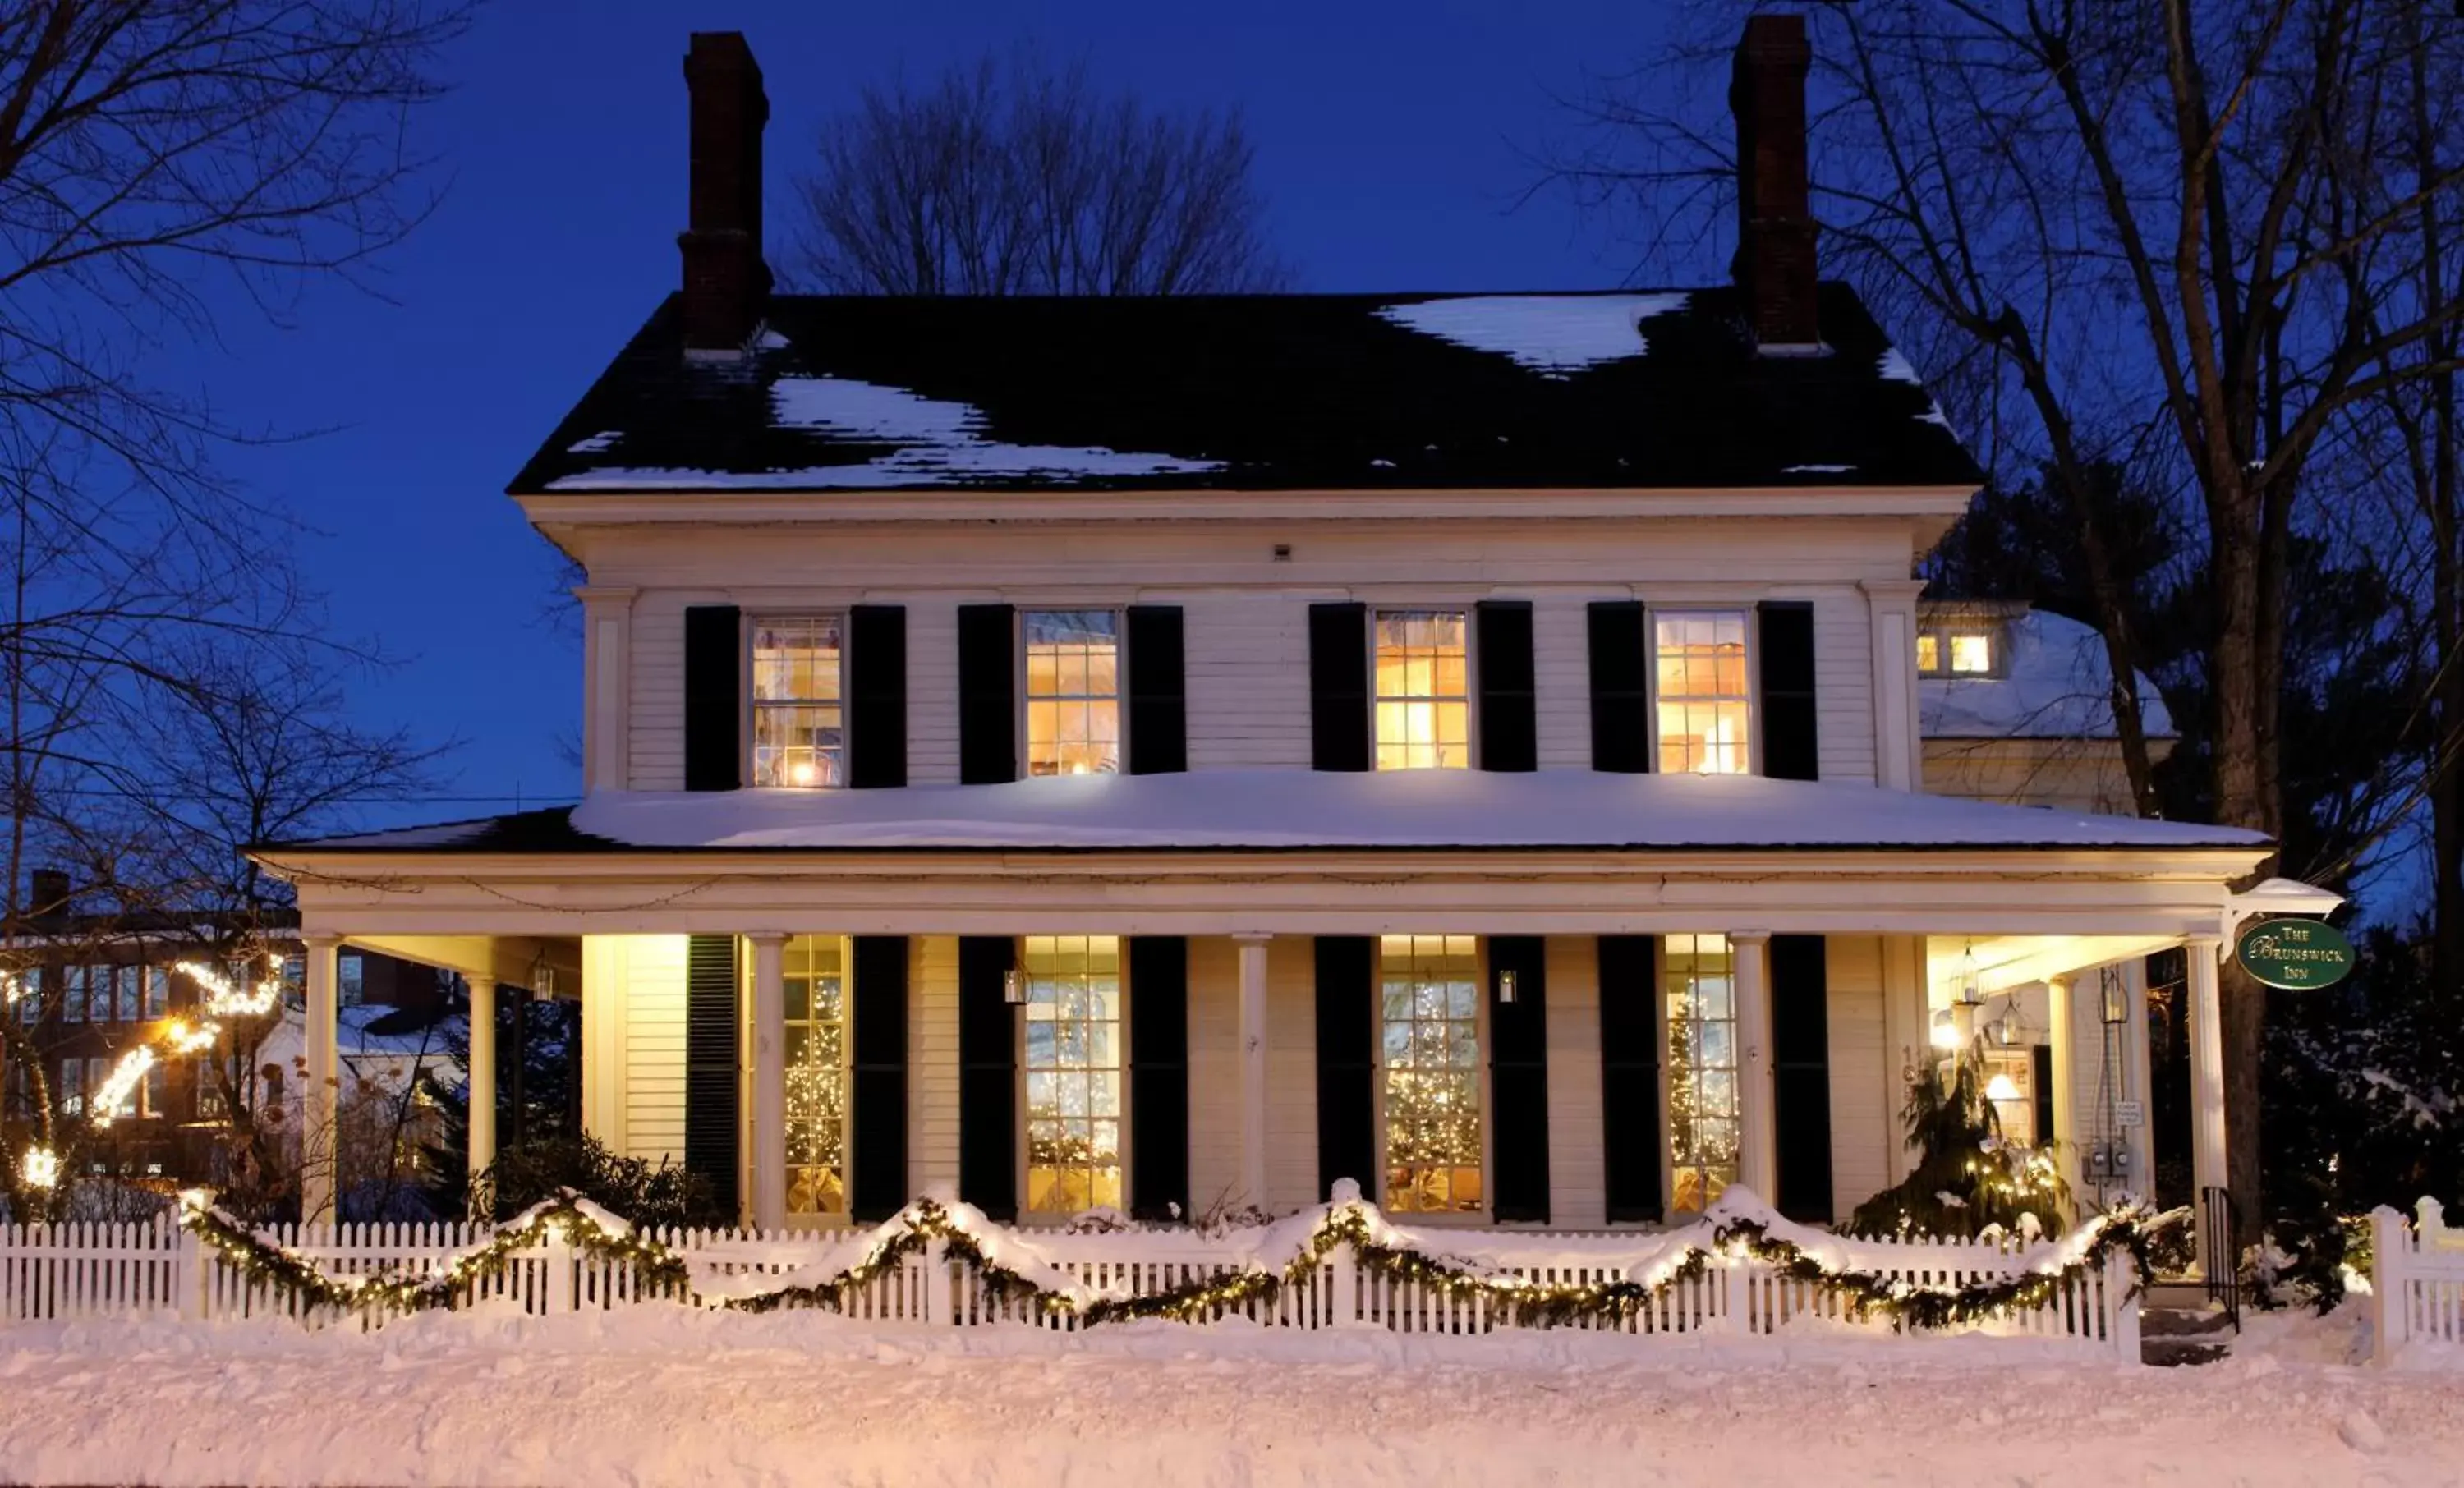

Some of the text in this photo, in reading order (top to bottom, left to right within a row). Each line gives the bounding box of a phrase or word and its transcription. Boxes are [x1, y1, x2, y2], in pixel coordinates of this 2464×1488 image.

[2282, 927, 2310, 942] THE
[2249, 935, 2345, 962] BRUNSWICK
[2284, 965, 2309, 980] INN
